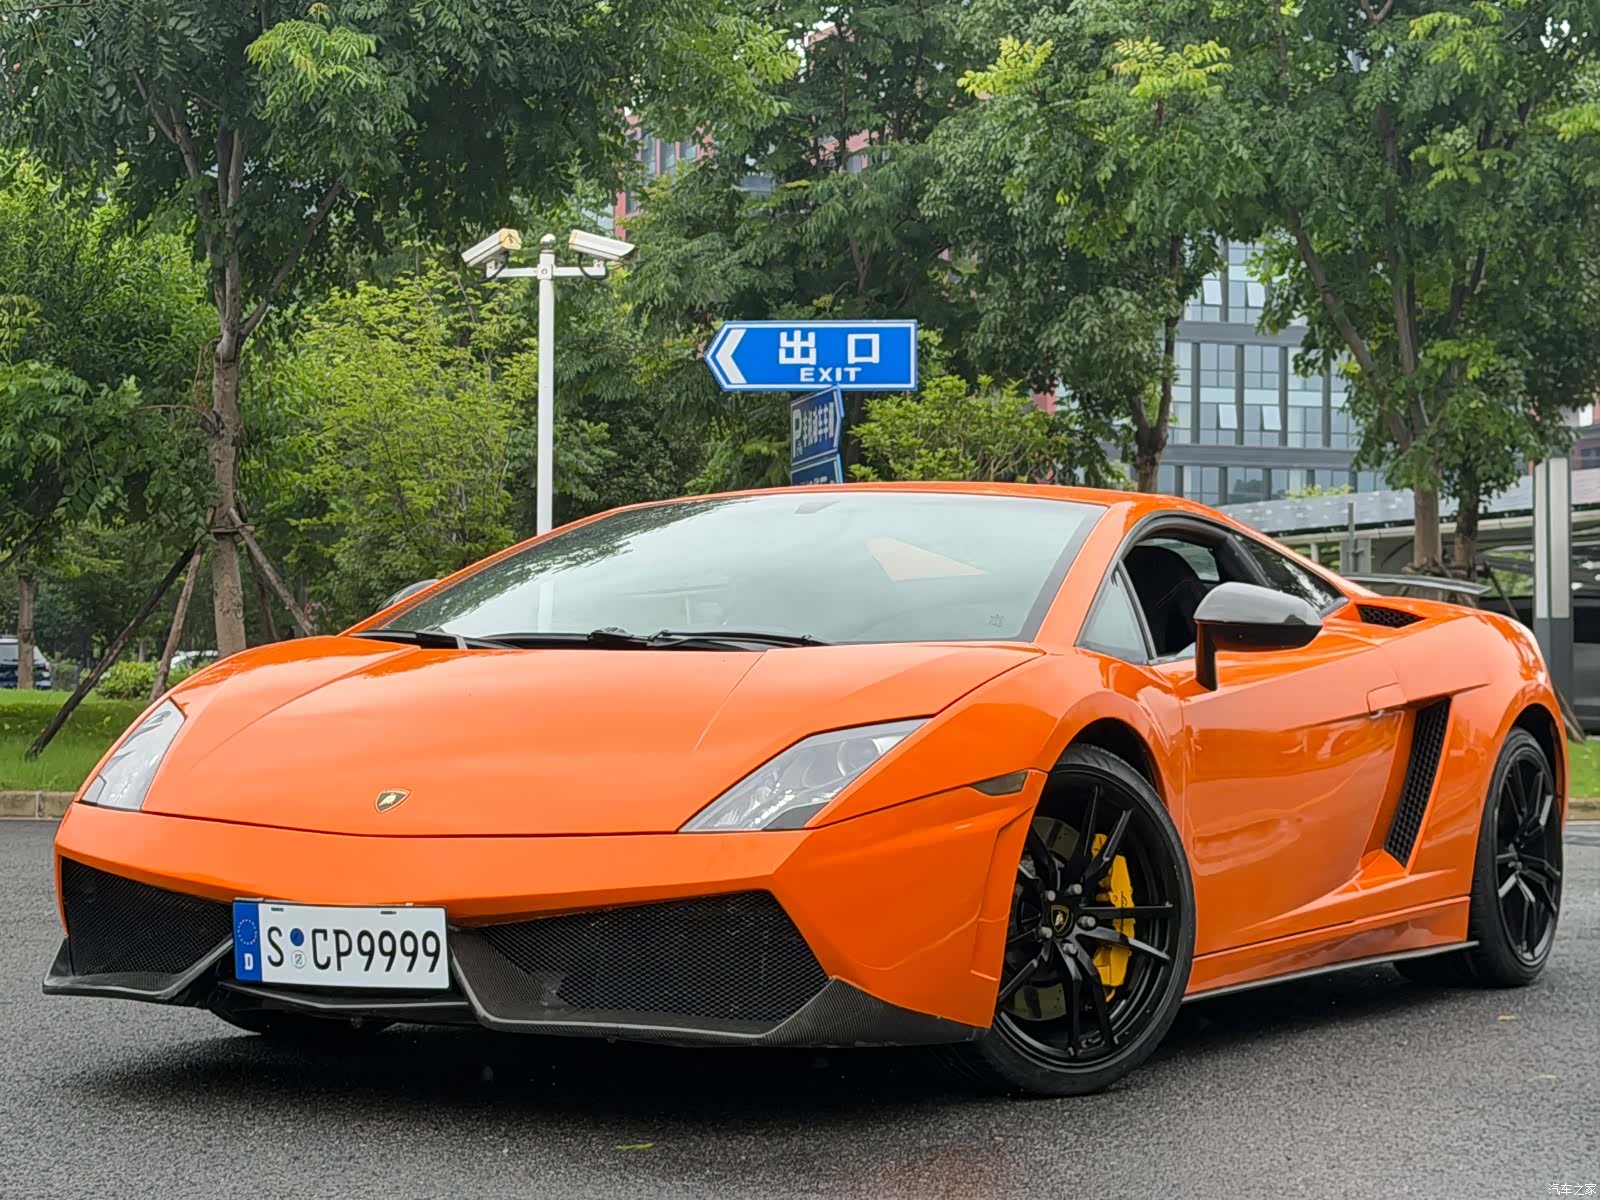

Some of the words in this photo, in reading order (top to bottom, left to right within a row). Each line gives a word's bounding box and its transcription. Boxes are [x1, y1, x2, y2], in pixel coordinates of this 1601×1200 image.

[779, 330, 880, 365] 出口
[800, 367, 862, 382] EXIT
[792, 408, 803, 458] P
[244, 952, 254, 970] D
[312, 928, 441, 973] CP9999
